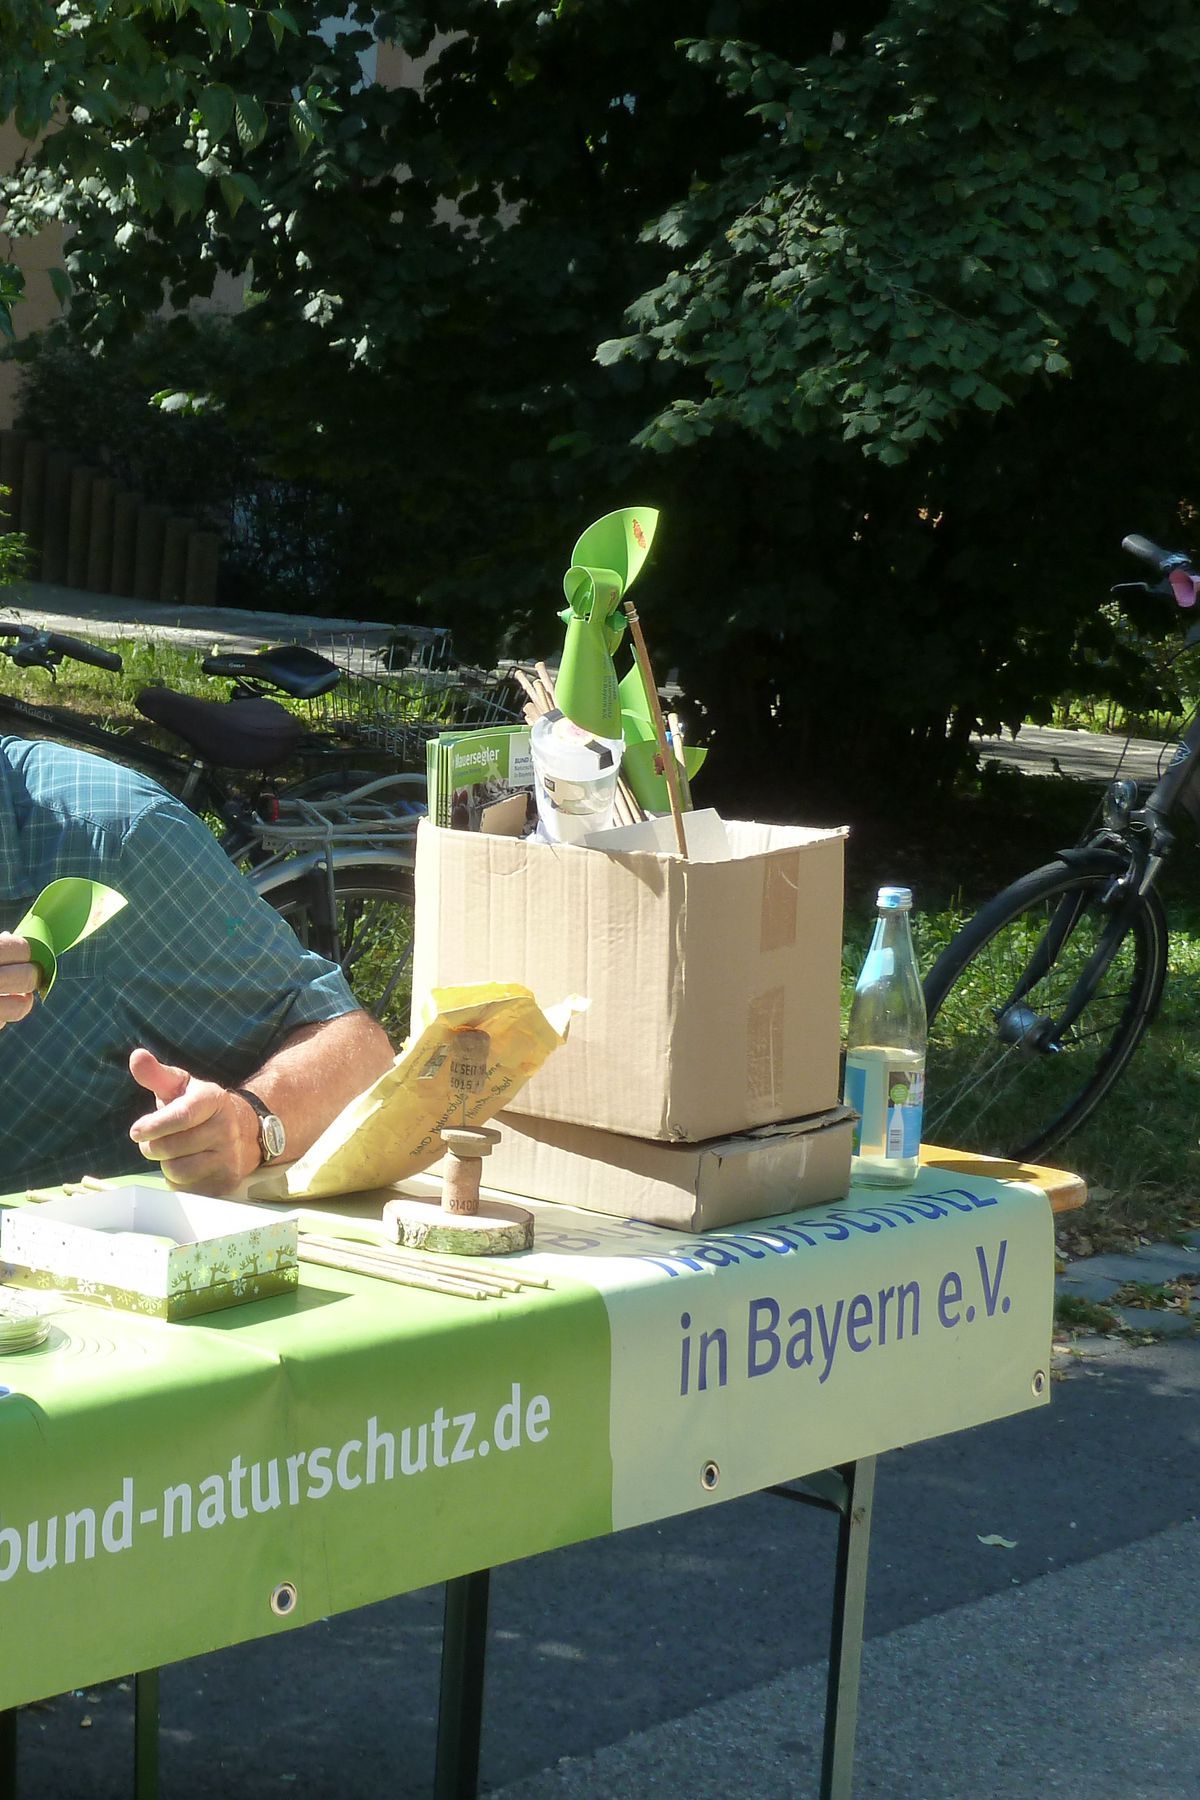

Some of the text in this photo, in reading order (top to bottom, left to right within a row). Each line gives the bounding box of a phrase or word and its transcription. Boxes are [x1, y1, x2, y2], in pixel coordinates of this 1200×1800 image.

[680, 1239, 1012, 1396] in Bayern e.V.
